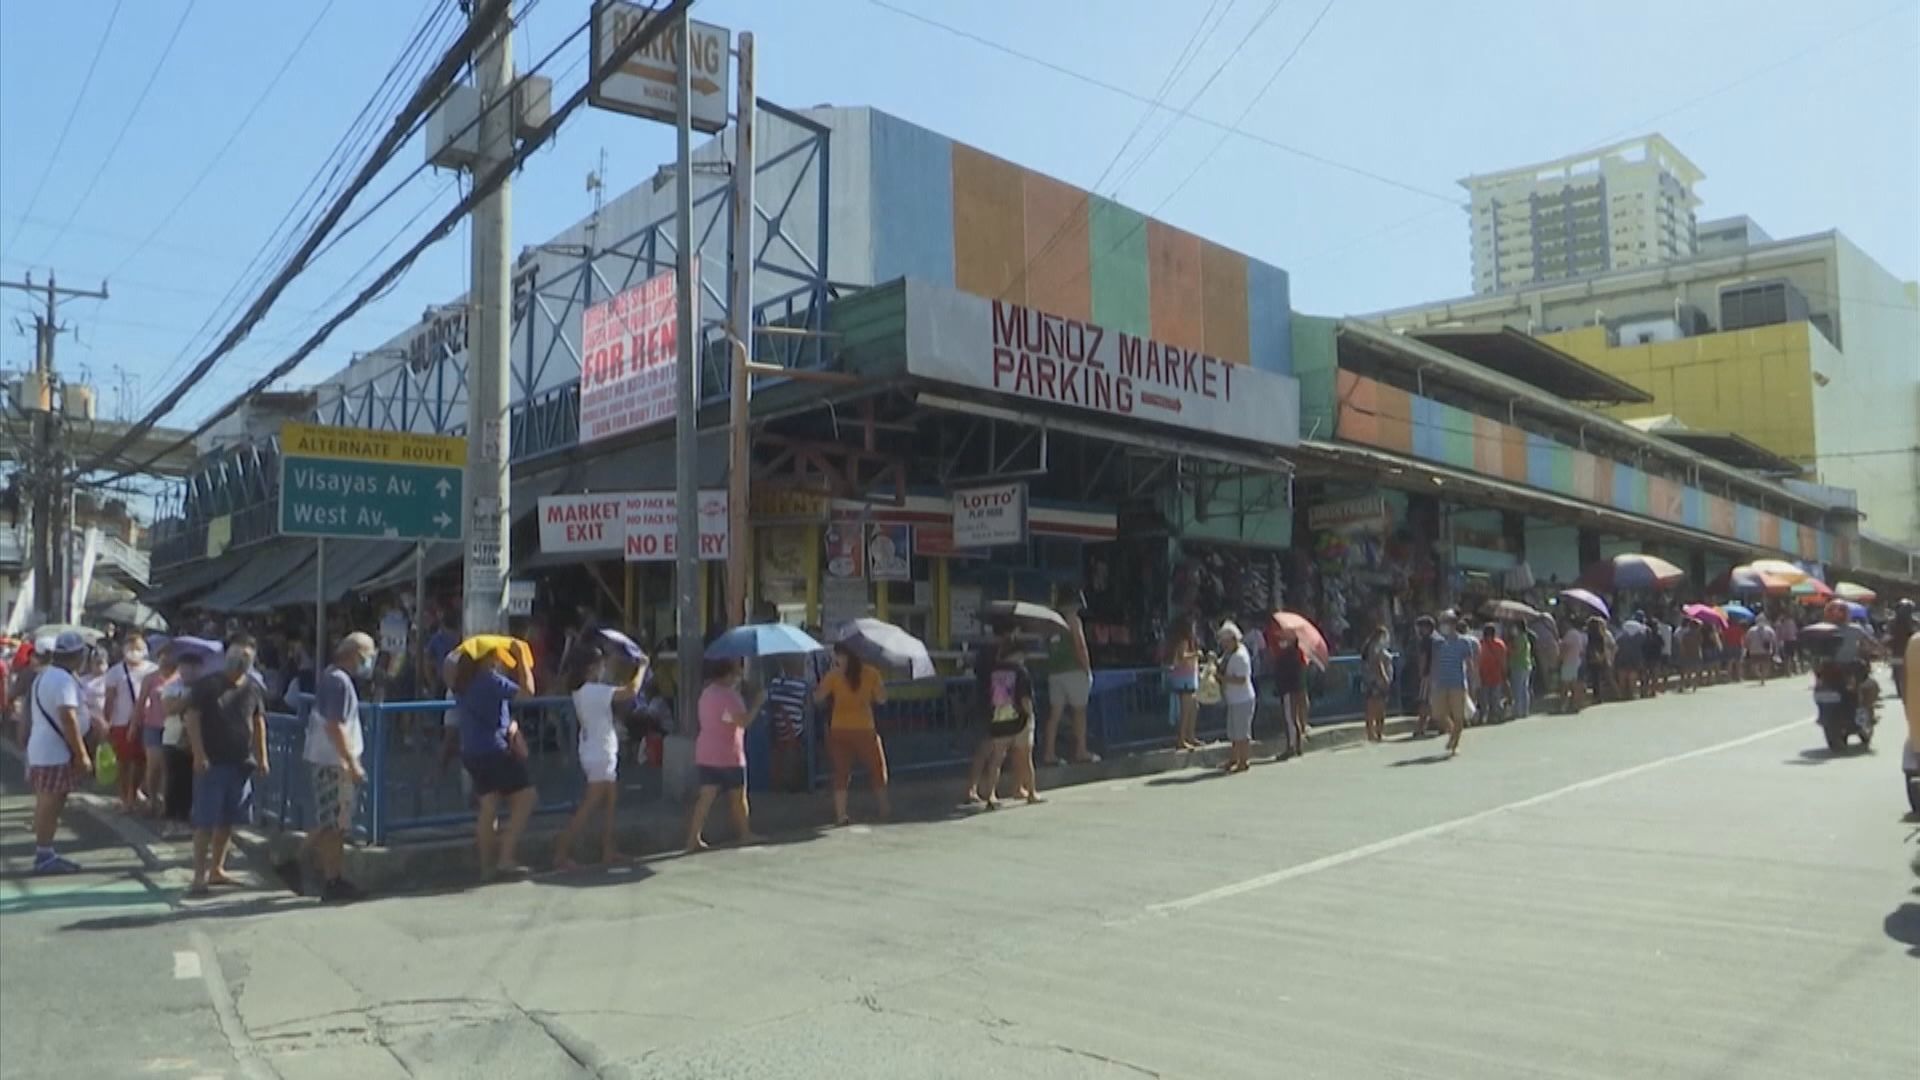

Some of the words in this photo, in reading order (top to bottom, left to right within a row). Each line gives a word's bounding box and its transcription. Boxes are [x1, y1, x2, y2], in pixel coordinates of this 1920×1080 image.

[612, 10, 719, 75] PRKNG
[582, 340, 625, 390] FOR
[631, 318, 678, 373] REN
[992, 298, 1105, 371] MUÑOZ
[1119, 331, 1235, 402] MARKET
[992, 347, 1133, 414] PARKING
[297, 436, 390, 458] ALTERNATE
[401, 446, 451, 462] ROUTE
[294, 467, 377, 497] Visayas
[386, 475, 416, 495] Av.
[293, 502, 348, 525] West
[357, 506, 387, 527] Av.
[547, 501, 621, 524] MARKET
[627, 499, 641, 509] NO
[643, 499, 663, 509] FACE
[627, 514, 641, 525] NO
[643, 514, 663, 524] FACE
[566, 523, 603, 543] EXIT
[627, 534, 657, 554] NO
[663, 533, 725, 554] ERY
